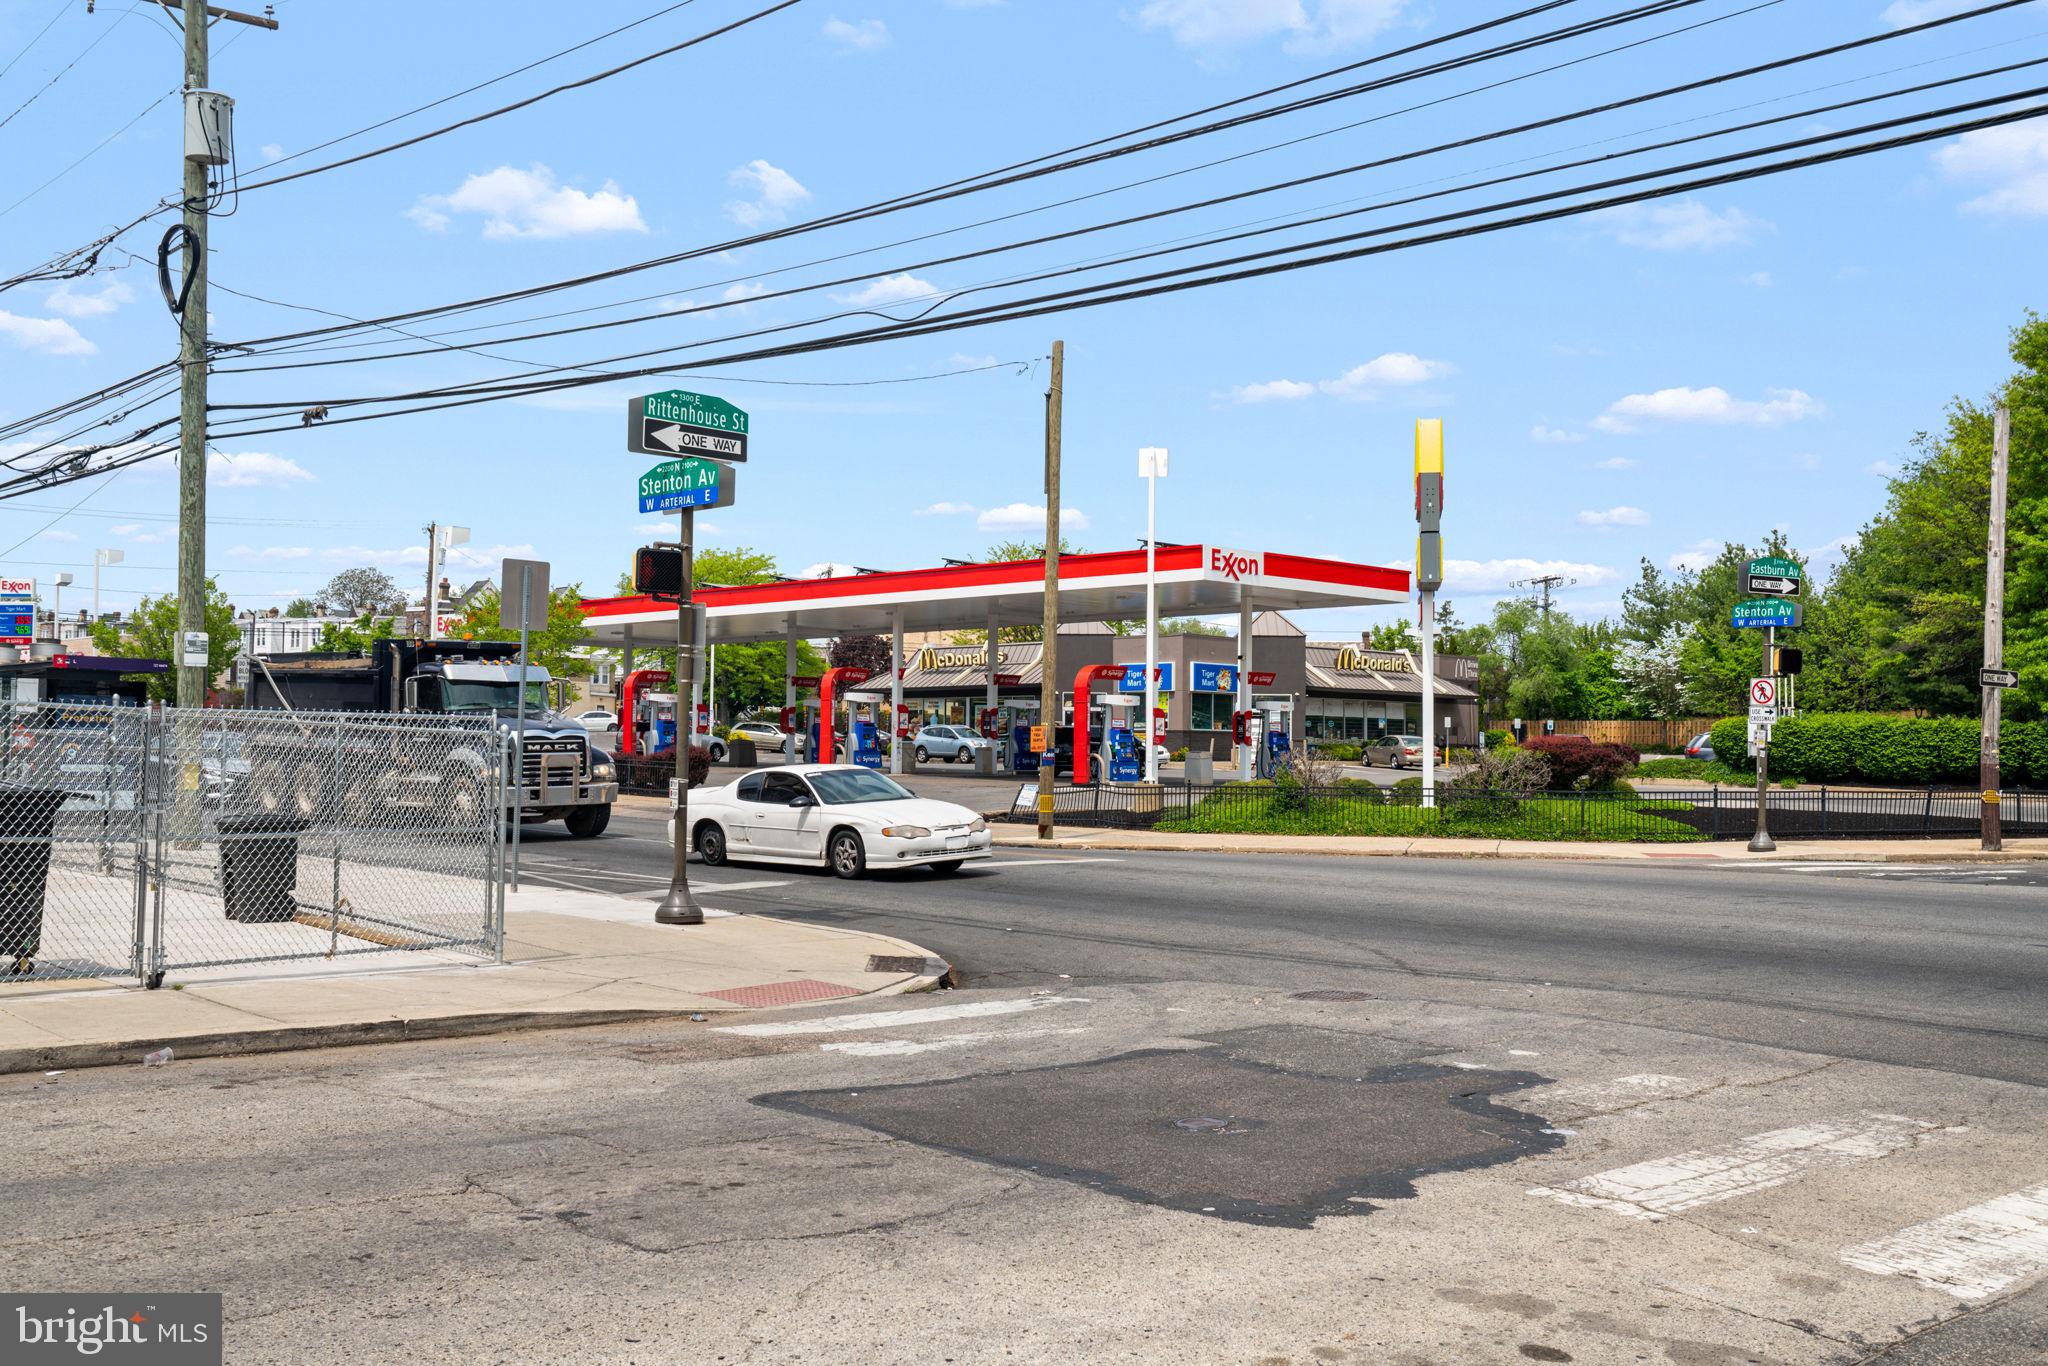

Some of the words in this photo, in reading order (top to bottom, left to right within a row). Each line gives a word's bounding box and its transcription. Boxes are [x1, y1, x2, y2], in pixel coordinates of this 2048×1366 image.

[680, 393, 694, 402] 1300
[695, 395, 700, 405] E
[648, 397, 727, 428] Rittenhouse
[732, 412, 745, 431] St
[682, 433, 708, 448] ONE
[713, 438, 737, 452] WAY
[674, 461, 680, 472] N
[641, 475, 691, 496] Stenton
[698, 468, 716, 487] Av
[645, 498, 655, 511] W
[660, 494, 695, 508] ARTERIAL
[704, 489, 711, 502] E
[1211, 547, 1259, 582] Exxon
[1750, 563, 1785, 576] Eastburn
[1788, 566, 1799, 577] Av
[1, 580, 31, 593] Exxon
[1754, 580, 1767, 588] ONE
[1769, 581, 1782, 589] WAY
[1735, 606, 1774, 618] Stenton
[1778, 605, 1792, 616] Av
[1737, 618, 1745, 627] W
[1749, 618, 1776, 626] ARTERIAL
[1783, 617, 1788, 625] E
[919, 648, 1007, 671] McDonals
[1337, 648, 1411, 672] McDonald's
[1127, 670, 1142, 679] Tiger
[1201, 669, 1216, 679] Tiger
[1984, 673, 1996, 681] ONE
[1127, 679, 1142, 687] Mart
[1201, 679, 1215, 687] Mart
[527, 743, 579, 751] MACK
[862, 755, 881, 764] Synergy
[1119, 765, 1137, 775] Synergy
